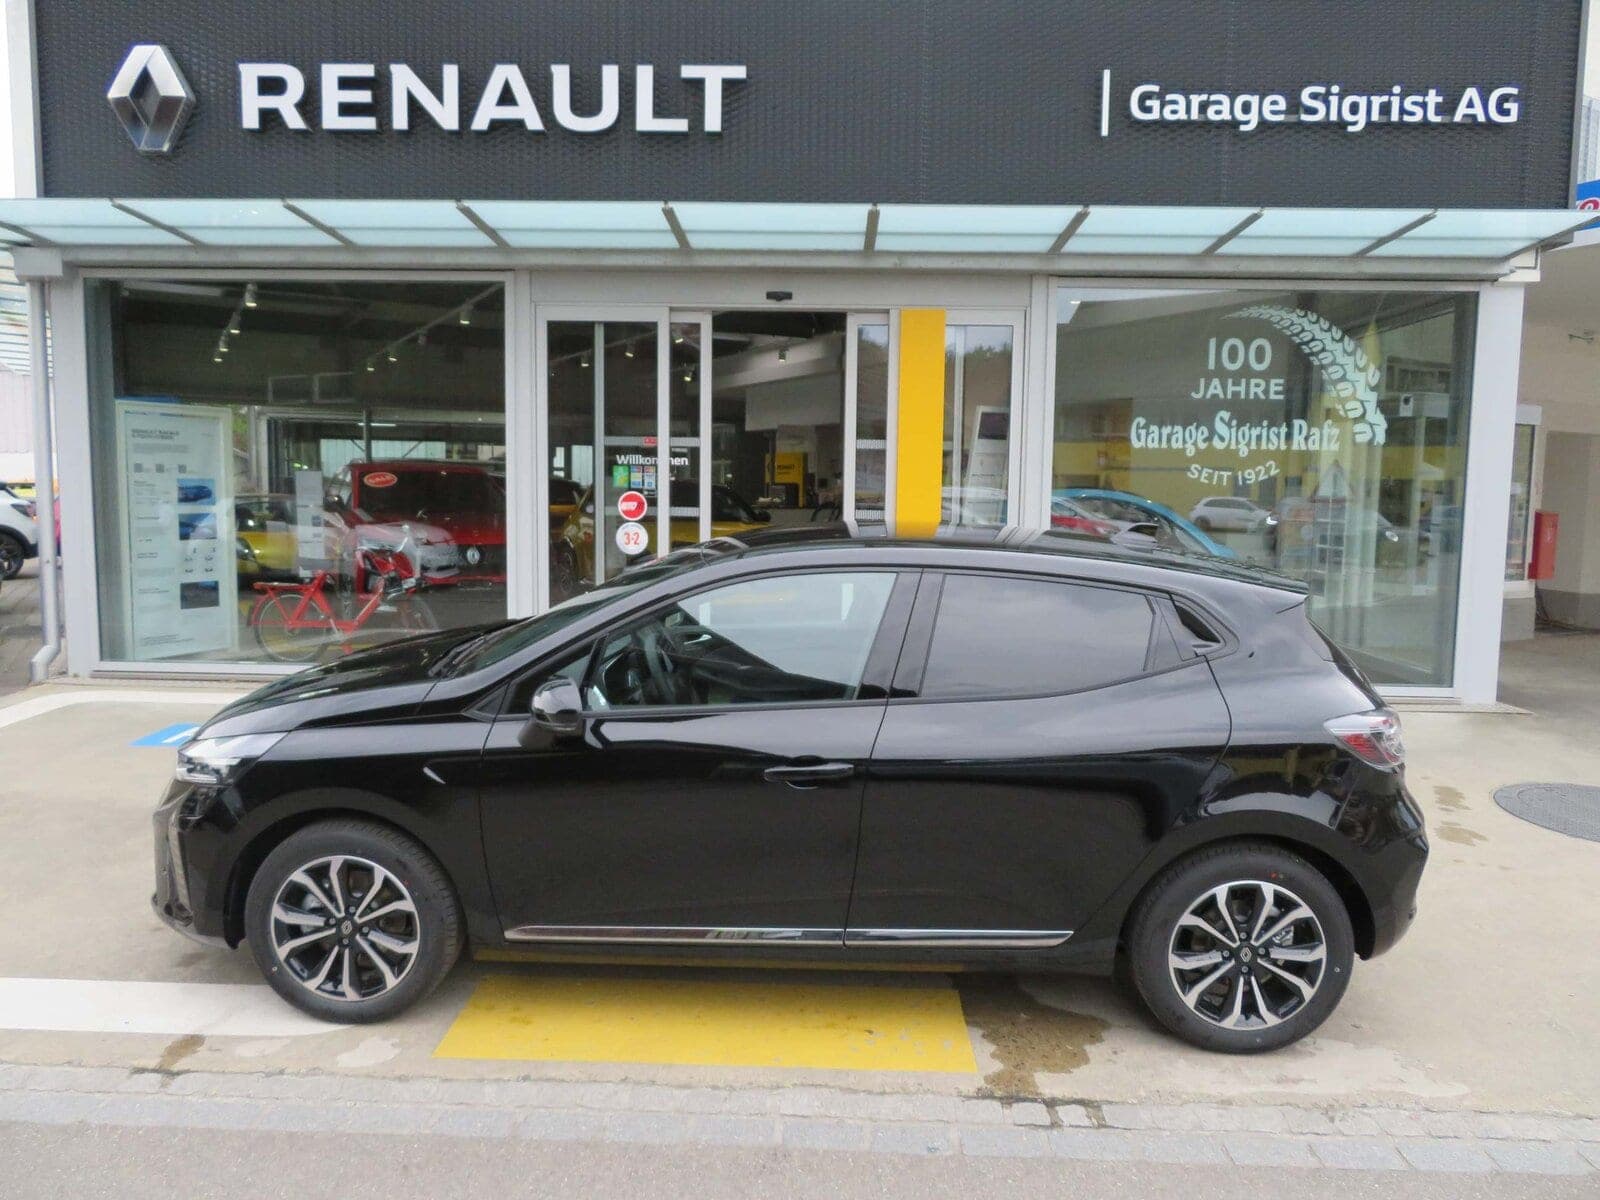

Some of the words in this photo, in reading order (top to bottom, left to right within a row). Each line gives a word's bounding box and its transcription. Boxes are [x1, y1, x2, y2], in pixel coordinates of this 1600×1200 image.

[238, 63, 747, 133] RENAULT
[1129, 84, 1286, 131] Garage
[1299, 85, 1443, 132] Sigrist
[1453, 87, 1519, 123] AG
[1207, 337, 1273, 371] 100
[1191, 378, 1285, 400] JAHRE
[1130, 416, 1208, 456] Garage
[1212, 410, 1288, 457] Sigrist
[1292, 418, 1340, 451] Rafz
[1186, 463, 1232, 486] SEIT
[1238, 460, 1279, 486] 1922
